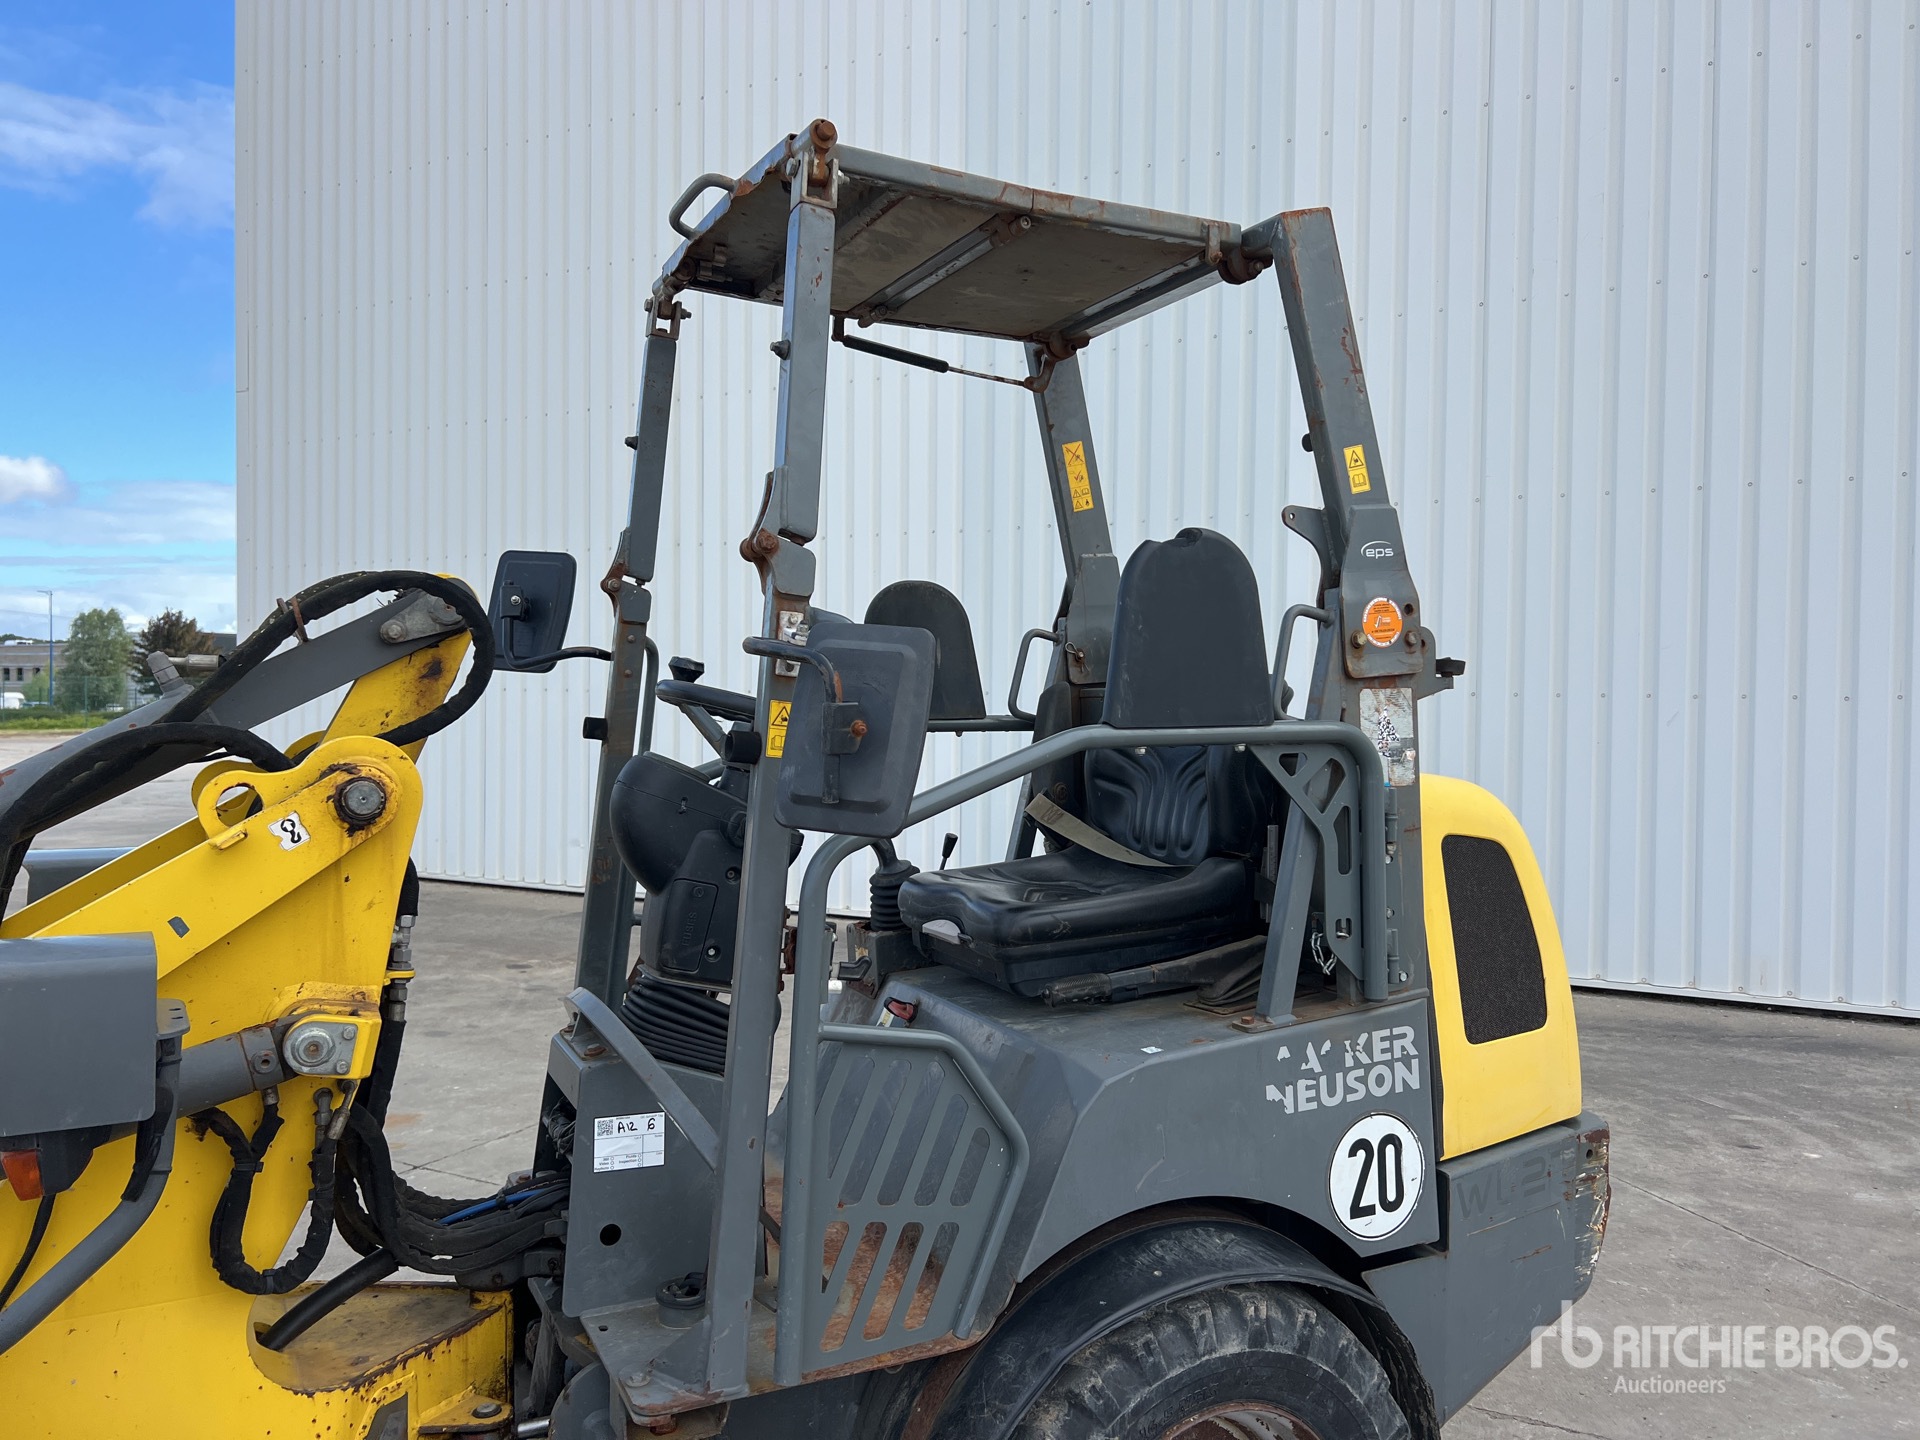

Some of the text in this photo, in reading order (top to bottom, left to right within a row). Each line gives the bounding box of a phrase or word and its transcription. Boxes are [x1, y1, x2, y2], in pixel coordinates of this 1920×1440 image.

[1366, 548, 1394, 560] eps
[1266, 1060, 1420, 1114] NEUSON
[1347, 1134, 1403, 1220] 20
